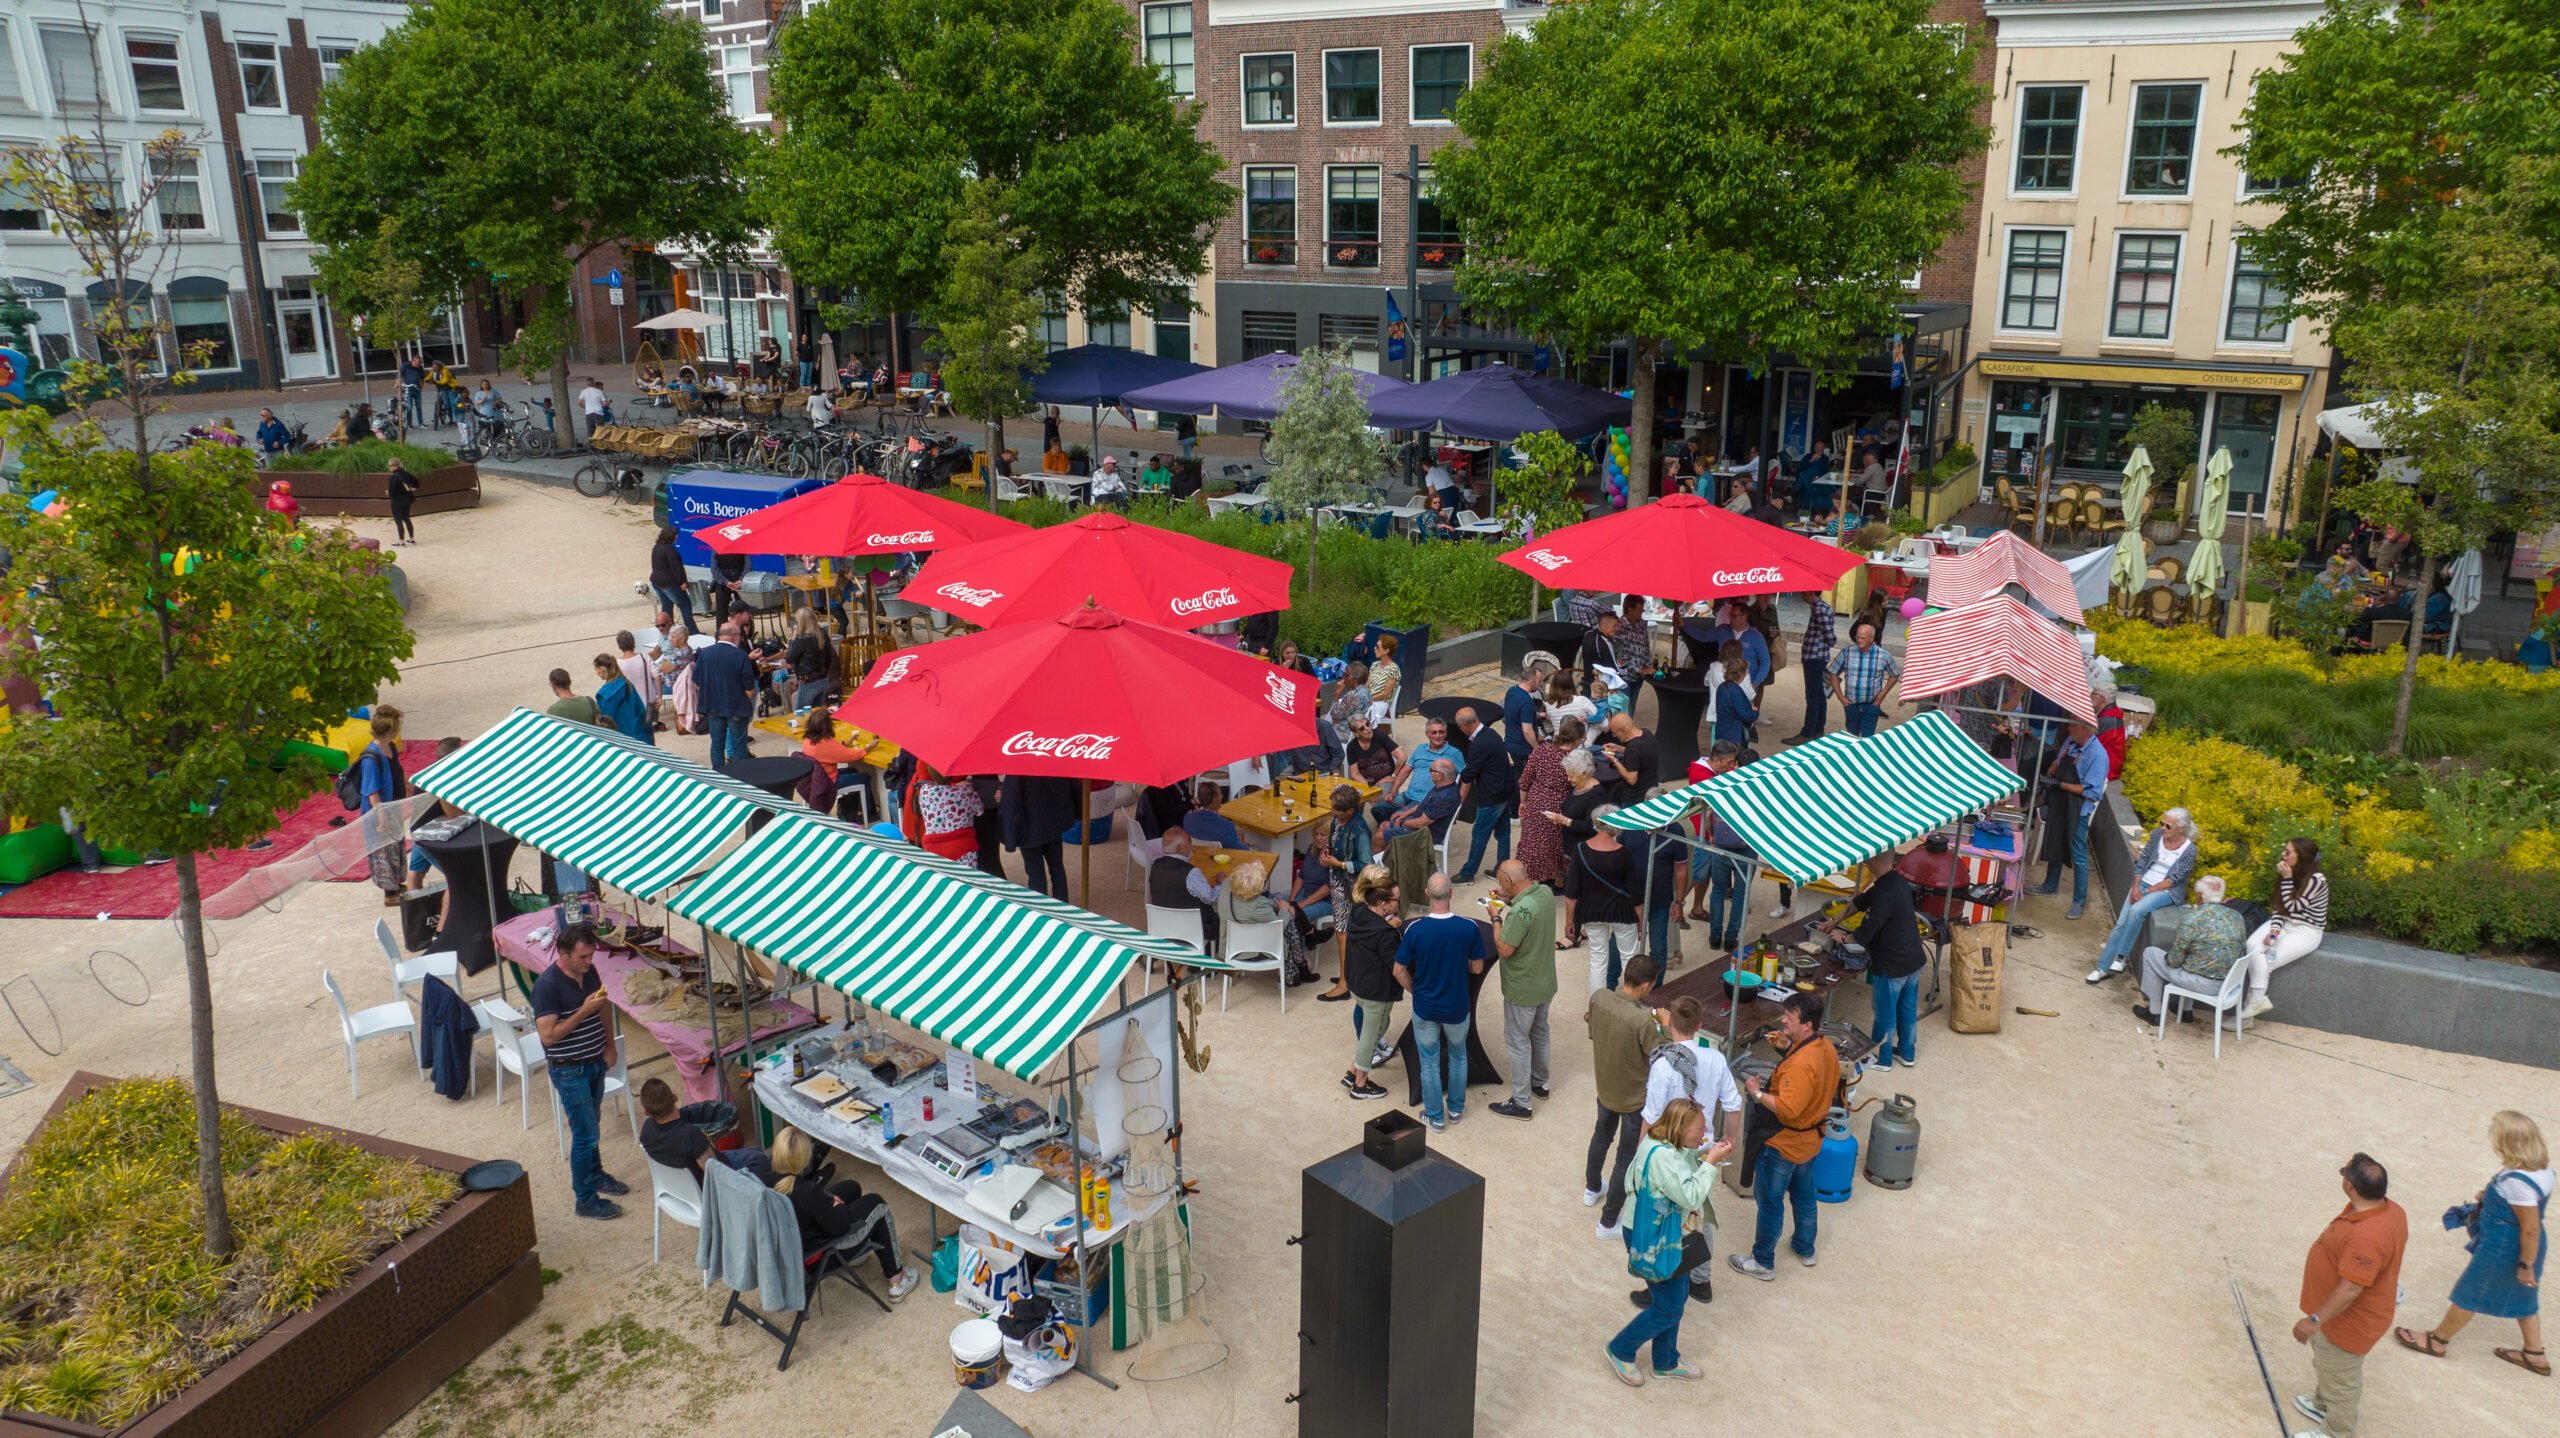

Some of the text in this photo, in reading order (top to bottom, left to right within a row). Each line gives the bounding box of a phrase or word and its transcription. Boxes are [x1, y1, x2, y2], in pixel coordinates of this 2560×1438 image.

[1986, 363, 2035, 374] CASTAFIORE
[867, 530, 935, 547] Coca-Cola
[1712, 567, 1784, 586] Coca-Cola
[1171, 587, 1240, 616] Coca-Cola
[1002, 731, 1120, 760] Coca-Cola
